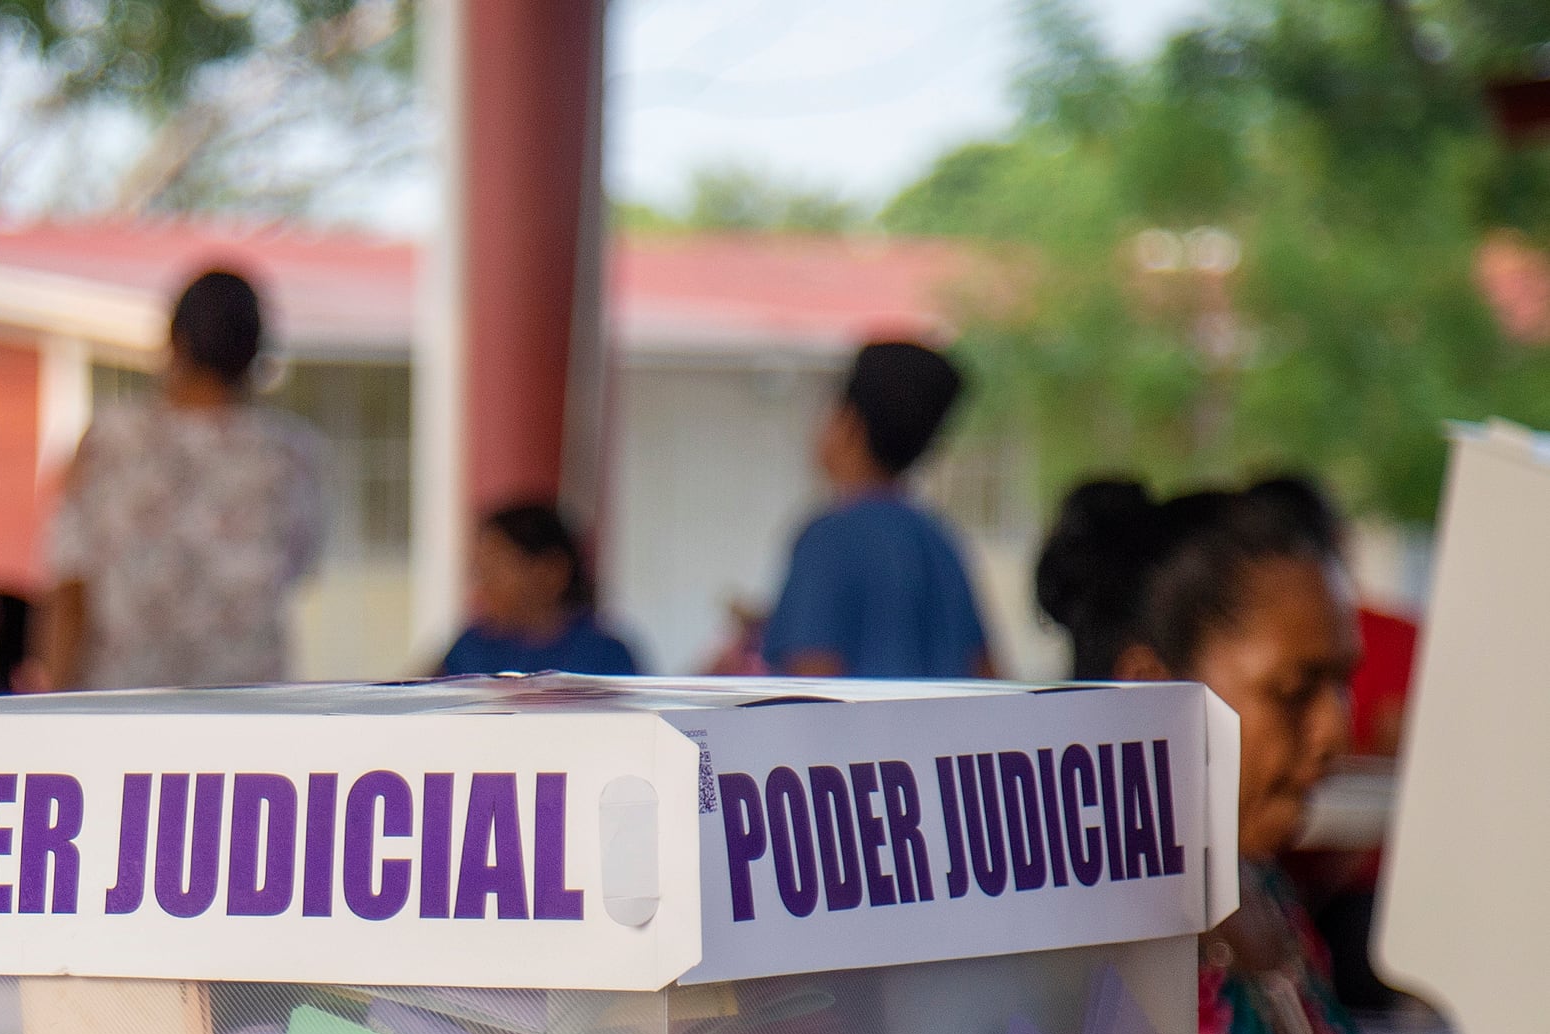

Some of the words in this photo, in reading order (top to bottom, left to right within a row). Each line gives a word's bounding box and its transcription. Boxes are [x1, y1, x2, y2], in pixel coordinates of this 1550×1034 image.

[105, 770, 584, 921] JUDICIAL
[717, 760, 935, 923] PODER
[935, 739, 1186, 899] JUDICIAL
